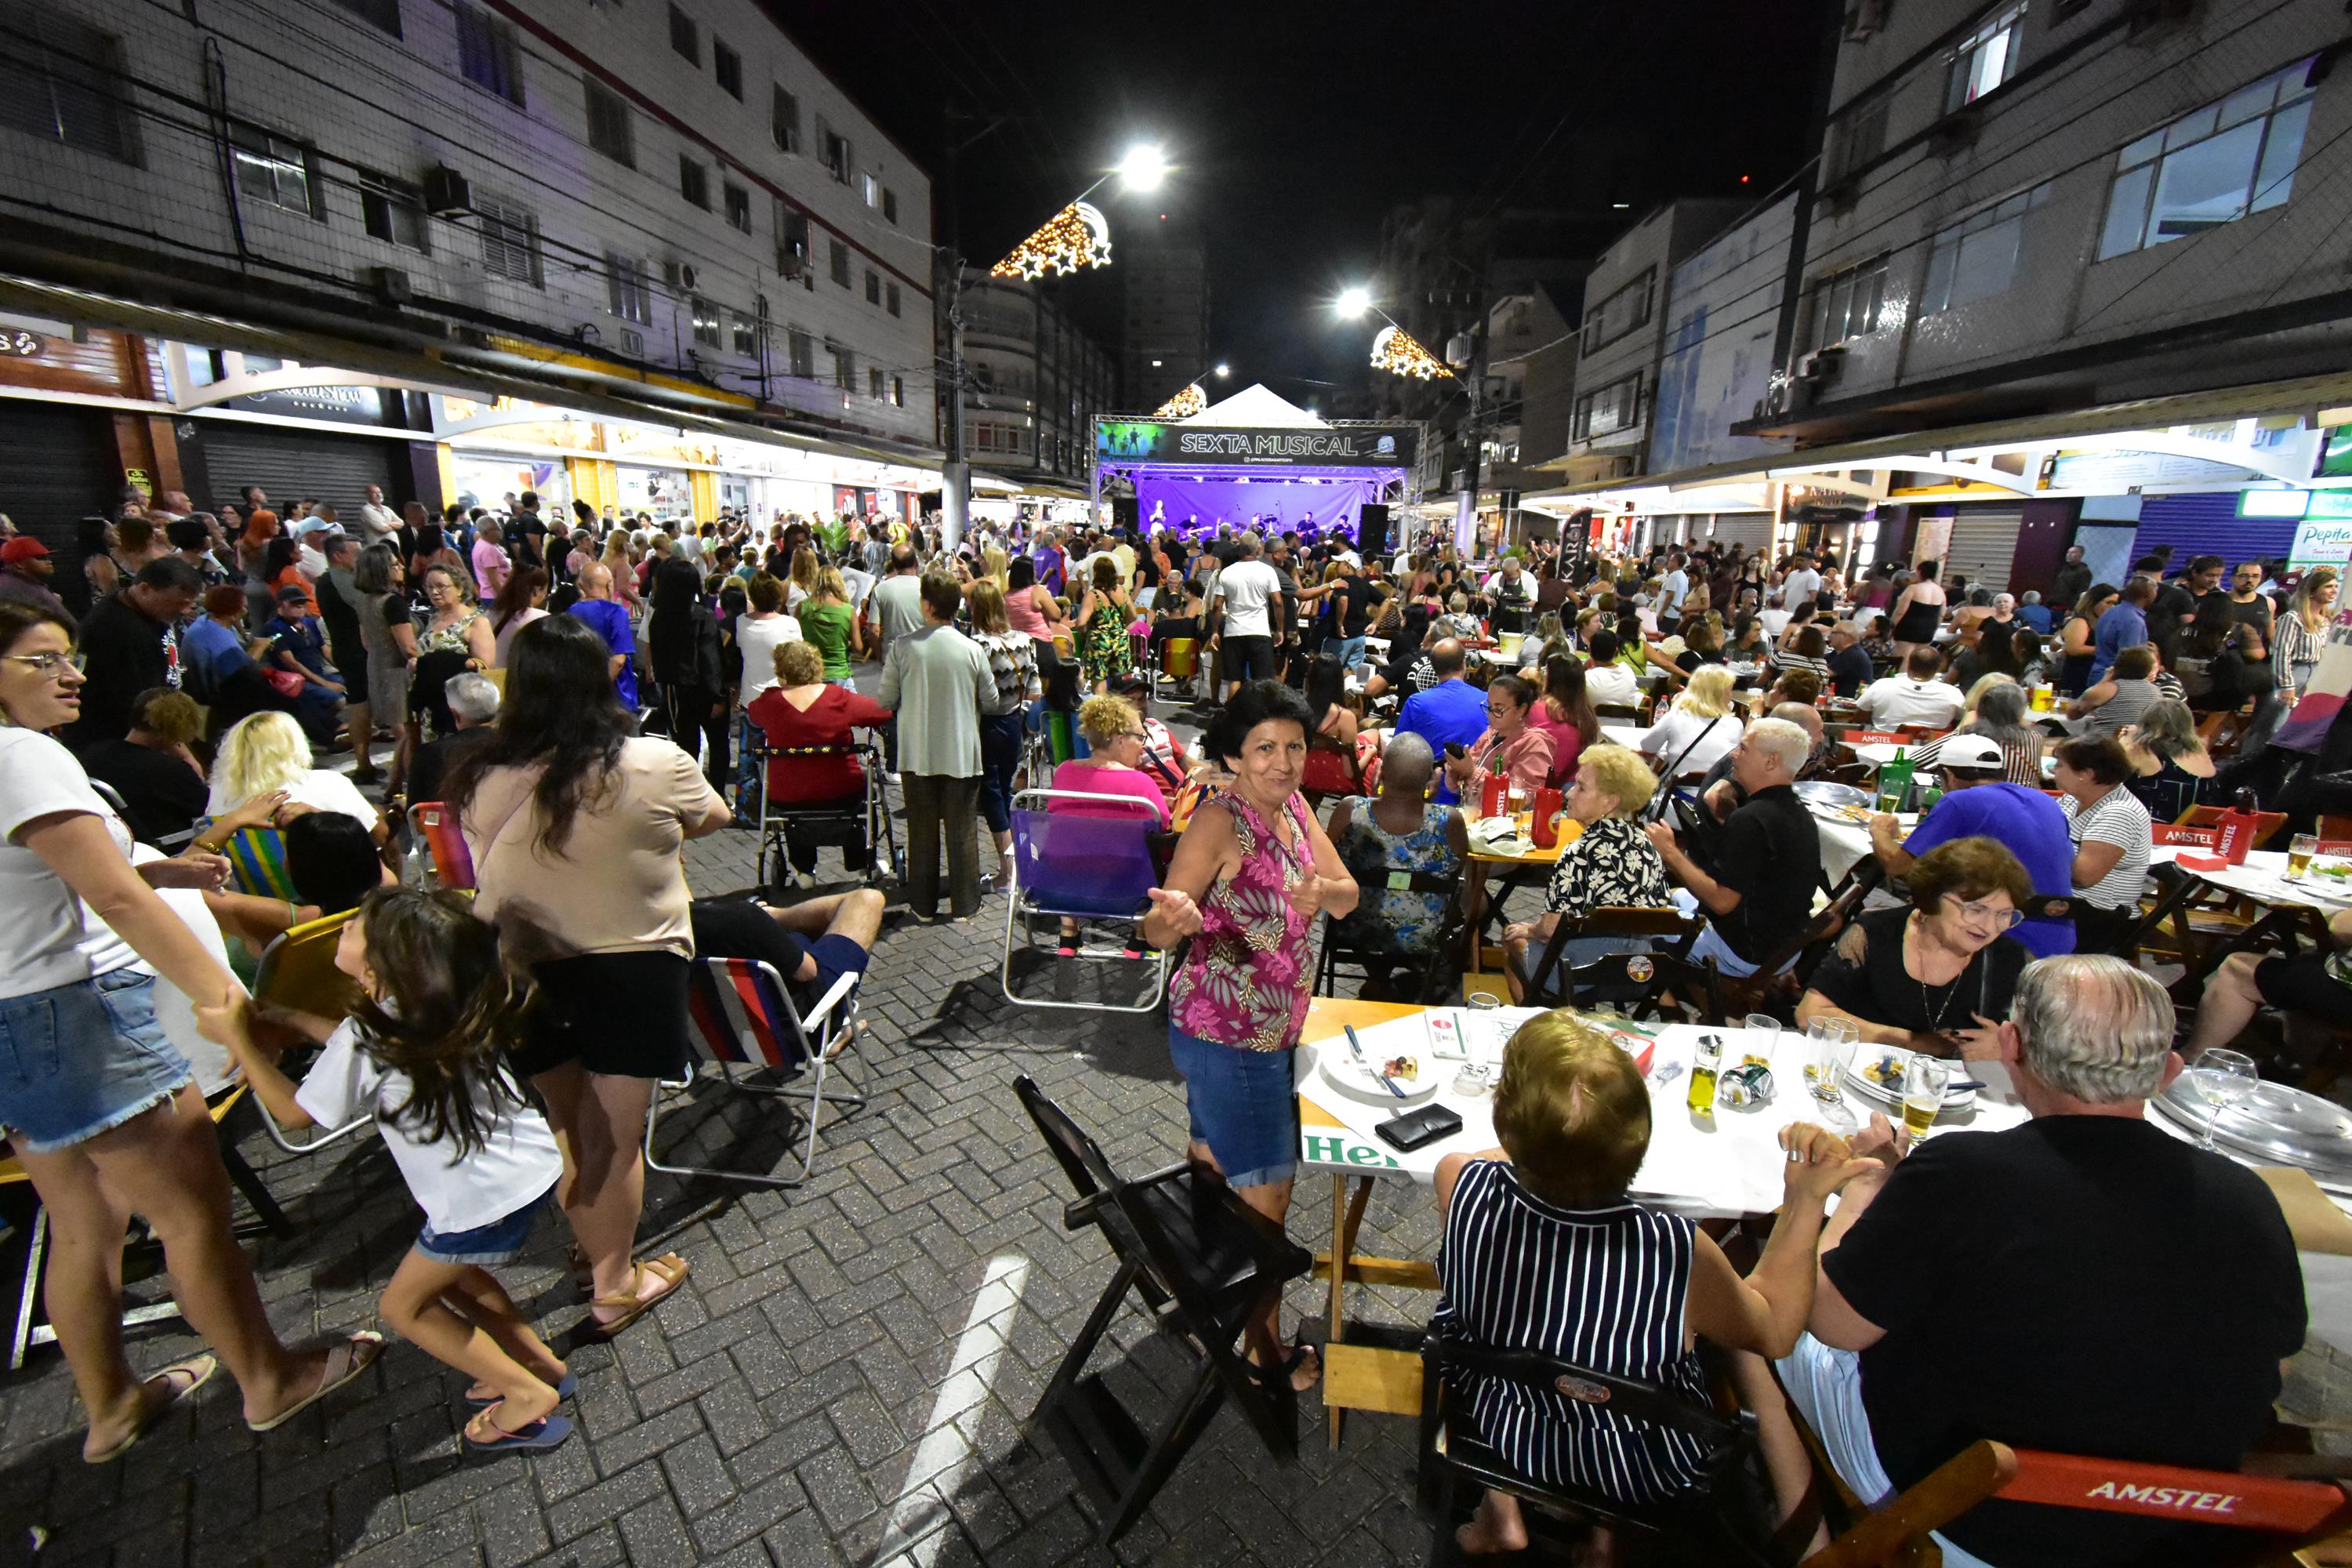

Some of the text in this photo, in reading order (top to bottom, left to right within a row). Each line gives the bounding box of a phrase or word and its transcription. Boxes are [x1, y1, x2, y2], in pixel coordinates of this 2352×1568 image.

[1181, 433, 1358, 456] SEXTA MUSICAL
[2303, 526, 2350, 545] Pepita
[1406, 656, 1431, 681] DRE
[1861, 735, 1891, 744] AMSTEL
[1496, 790, 1506, 817] MSTEL
[2165, 830, 2213, 844] AMSTEL
[2218, 824, 2237, 856] AMSTEL
[2323, 847, 2352, 857] AMSTEL
[2085, 1482, 2235, 1512] AMSTEL
